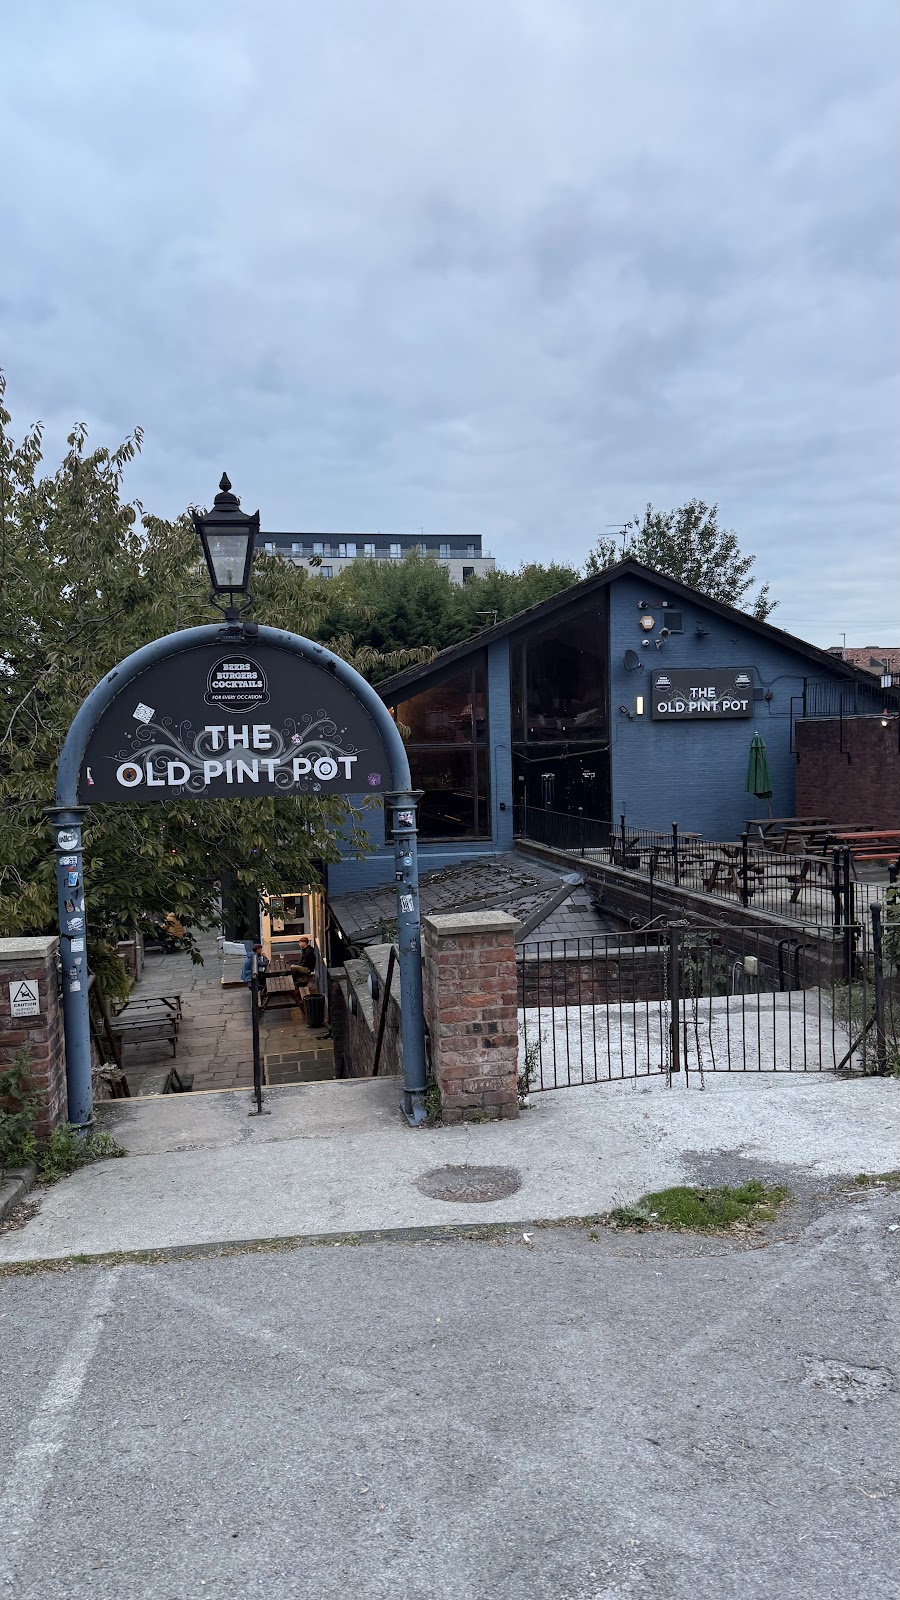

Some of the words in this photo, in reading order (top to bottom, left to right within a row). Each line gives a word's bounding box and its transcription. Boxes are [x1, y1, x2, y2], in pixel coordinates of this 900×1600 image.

[222, 663, 251, 671] BEERS
[216, 672, 258, 680] BURGERS
[211, 680, 263, 688] COCKTAILS
[689, 686, 716, 698] THE
[657, 701, 685, 713] OLD
[688, 700, 719, 712] PINT
[722, 699, 749, 711] POT
[204, 724, 271, 750] THE
[116, 761, 191, 788] OLD
[203, 758, 281, 785] PINT
[292, 755, 358, 782] POT
